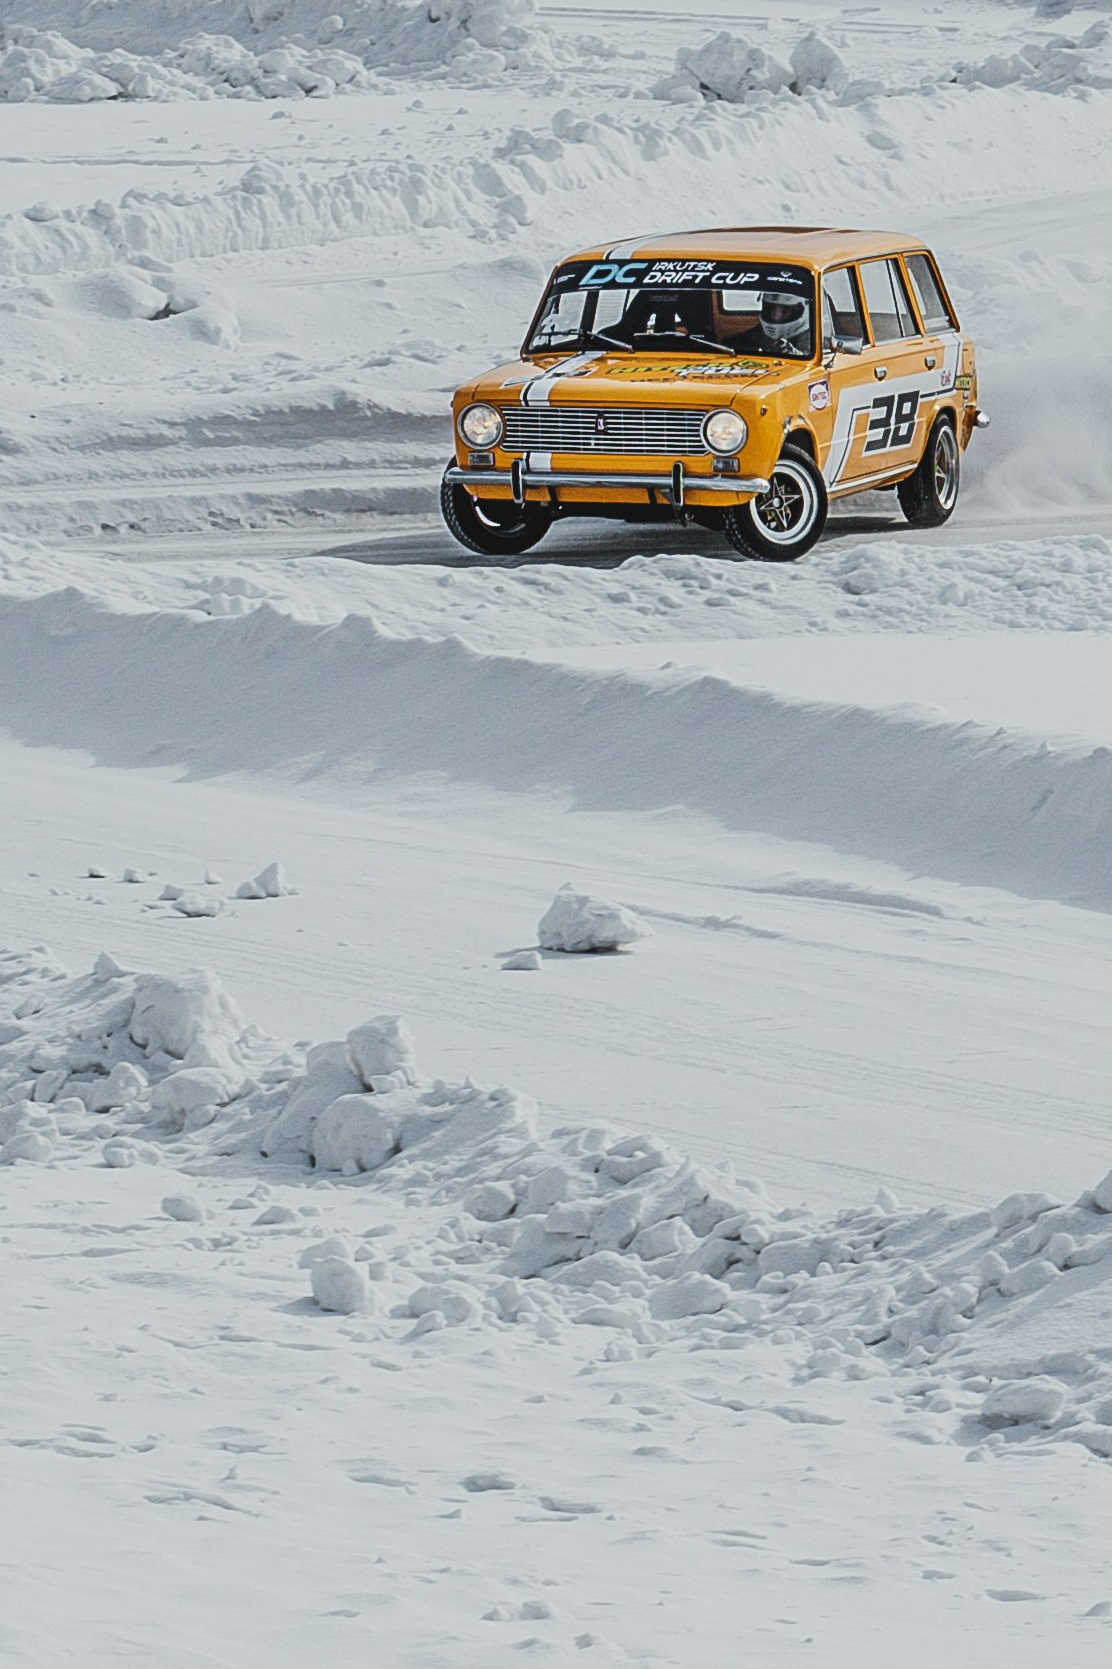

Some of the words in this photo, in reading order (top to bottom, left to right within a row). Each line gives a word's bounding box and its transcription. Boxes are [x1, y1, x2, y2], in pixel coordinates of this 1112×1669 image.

[578, 262, 649, 285] DC
[652, 261, 717, 271] IRKUTSK
[642, 271, 711, 284] DRIFT
[711, 272, 760, 285] CUP
[863, 390, 920, 453] 38
